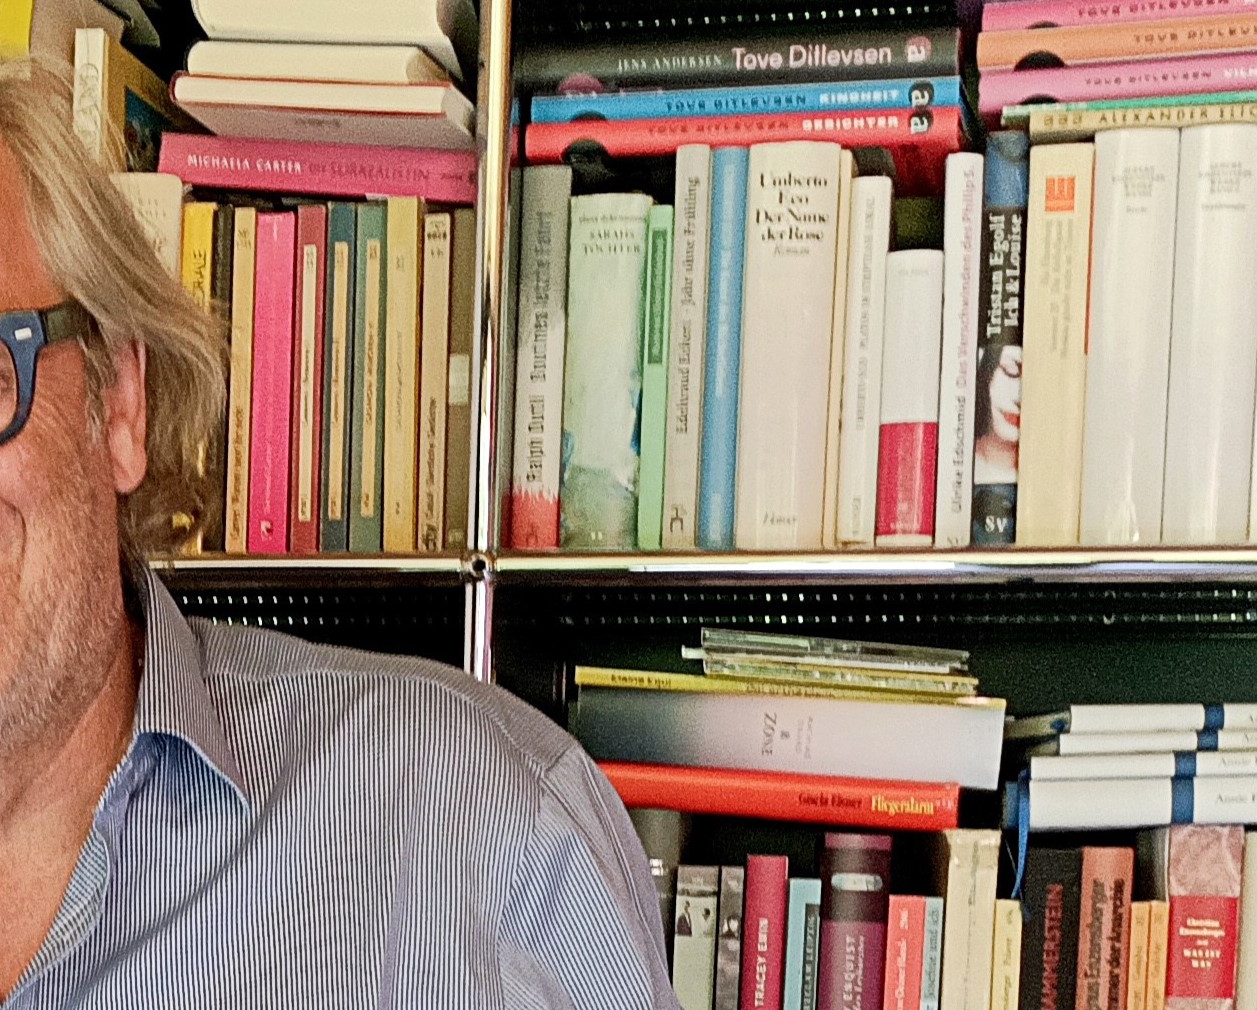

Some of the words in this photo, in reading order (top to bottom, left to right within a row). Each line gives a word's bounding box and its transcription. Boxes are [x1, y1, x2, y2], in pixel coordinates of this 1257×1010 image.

[617, 57, 648, 72] JENS
[652, 53, 723, 71] ANDERSEN
[732, 46, 783, 72] Tove
[788, 43, 893, 69] Ditlevsen
[665, 100, 707, 113] TOVE
[713, 94, 807, 111] DITLEVSEN
[1098, 107, 1208, 124] ALEXANDER
[186, 153, 251, 172] MICHAELA
[255, 157, 302, 174] CARTER
[759, 172, 829, 189] Umberto
[777, 190, 810, 207] Eco
[755, 208, 782, 226] Der
[787, 208, 830, 226] Name
[762, 226, 784, 242] der
[785, 227, 824, 242] Rose
[988, 212, 1007, 266] Egolf
[1004, 213, 1023, 277] Louise
[986, 269, 1004, 338] Tristan
[1003, 297, 1020, 328] Ich
[869, 795, 935, 817] Fliegeralarm
[1107, 878, 1125, 944] Anarchie
[1084, 878, 1108, 980] Enzensberger
[842, 933, 856, 1001] ENQUIST
[1105, 945, 1121, 969] der
[753, 956, 768, 1007] TRACEY
